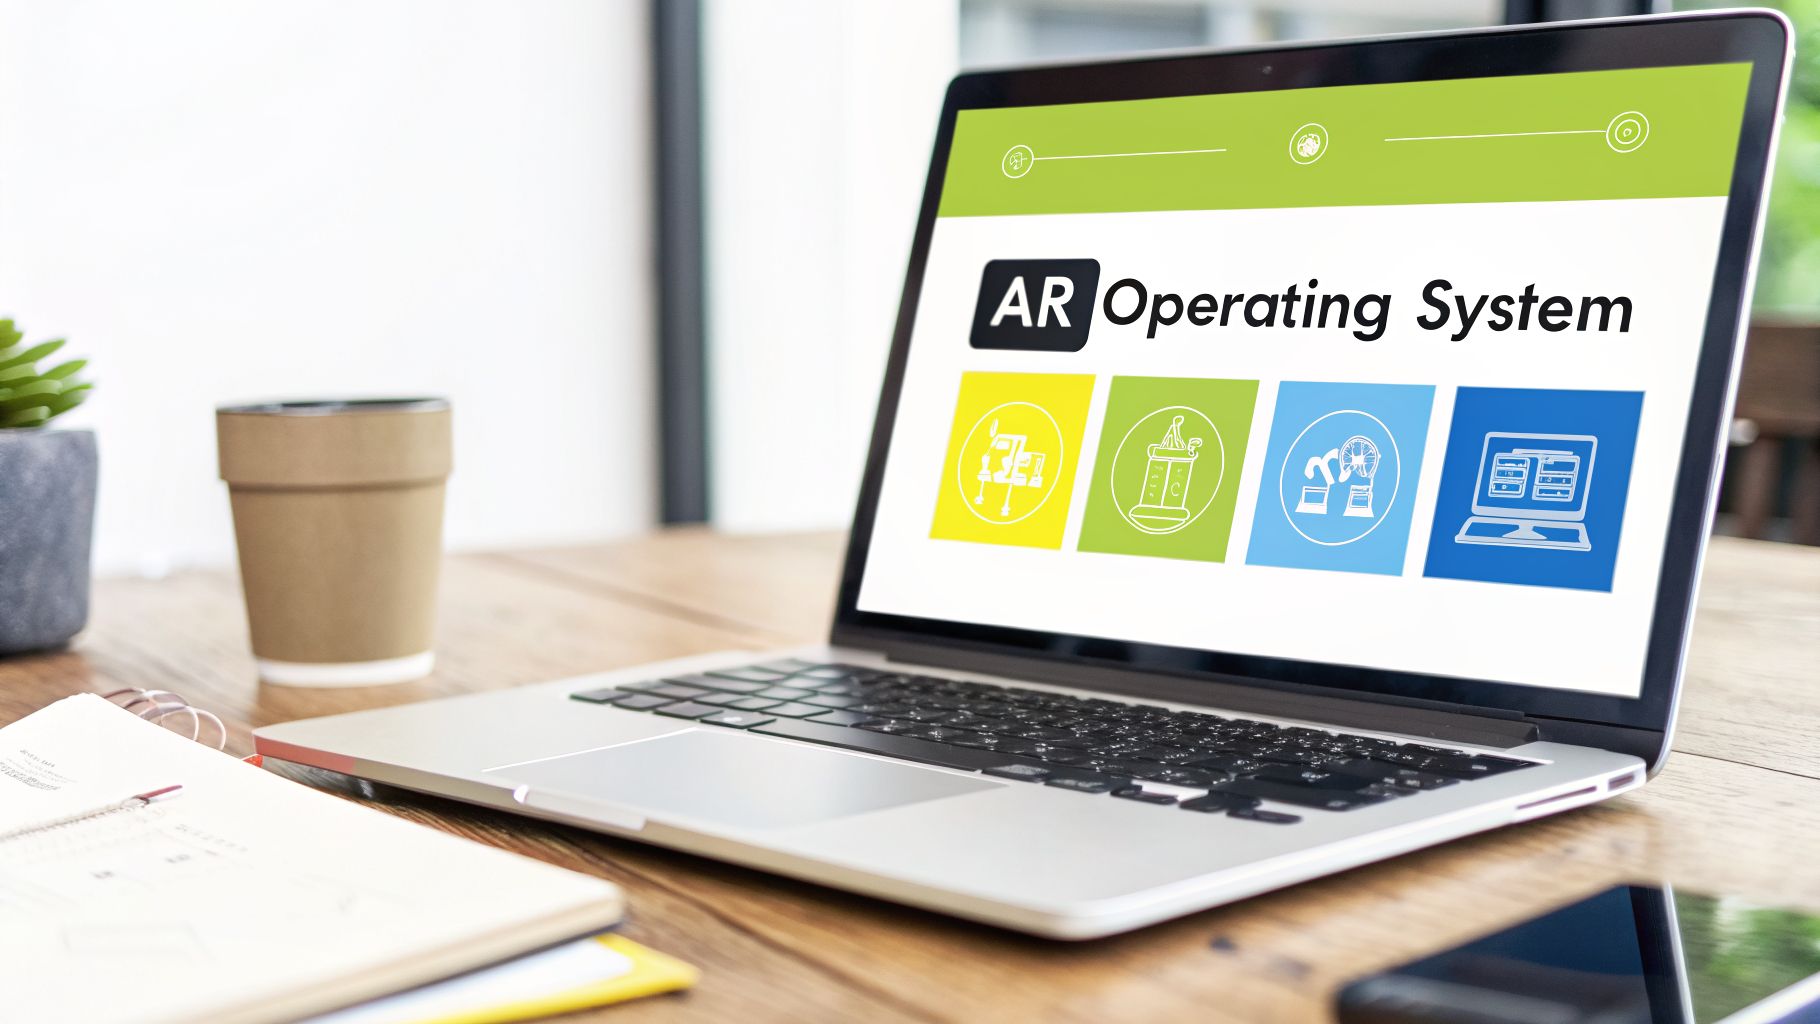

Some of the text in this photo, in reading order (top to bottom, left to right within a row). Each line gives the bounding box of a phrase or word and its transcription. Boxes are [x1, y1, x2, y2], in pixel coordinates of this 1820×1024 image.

[990, 275, 1633, 342] AR Operating System
